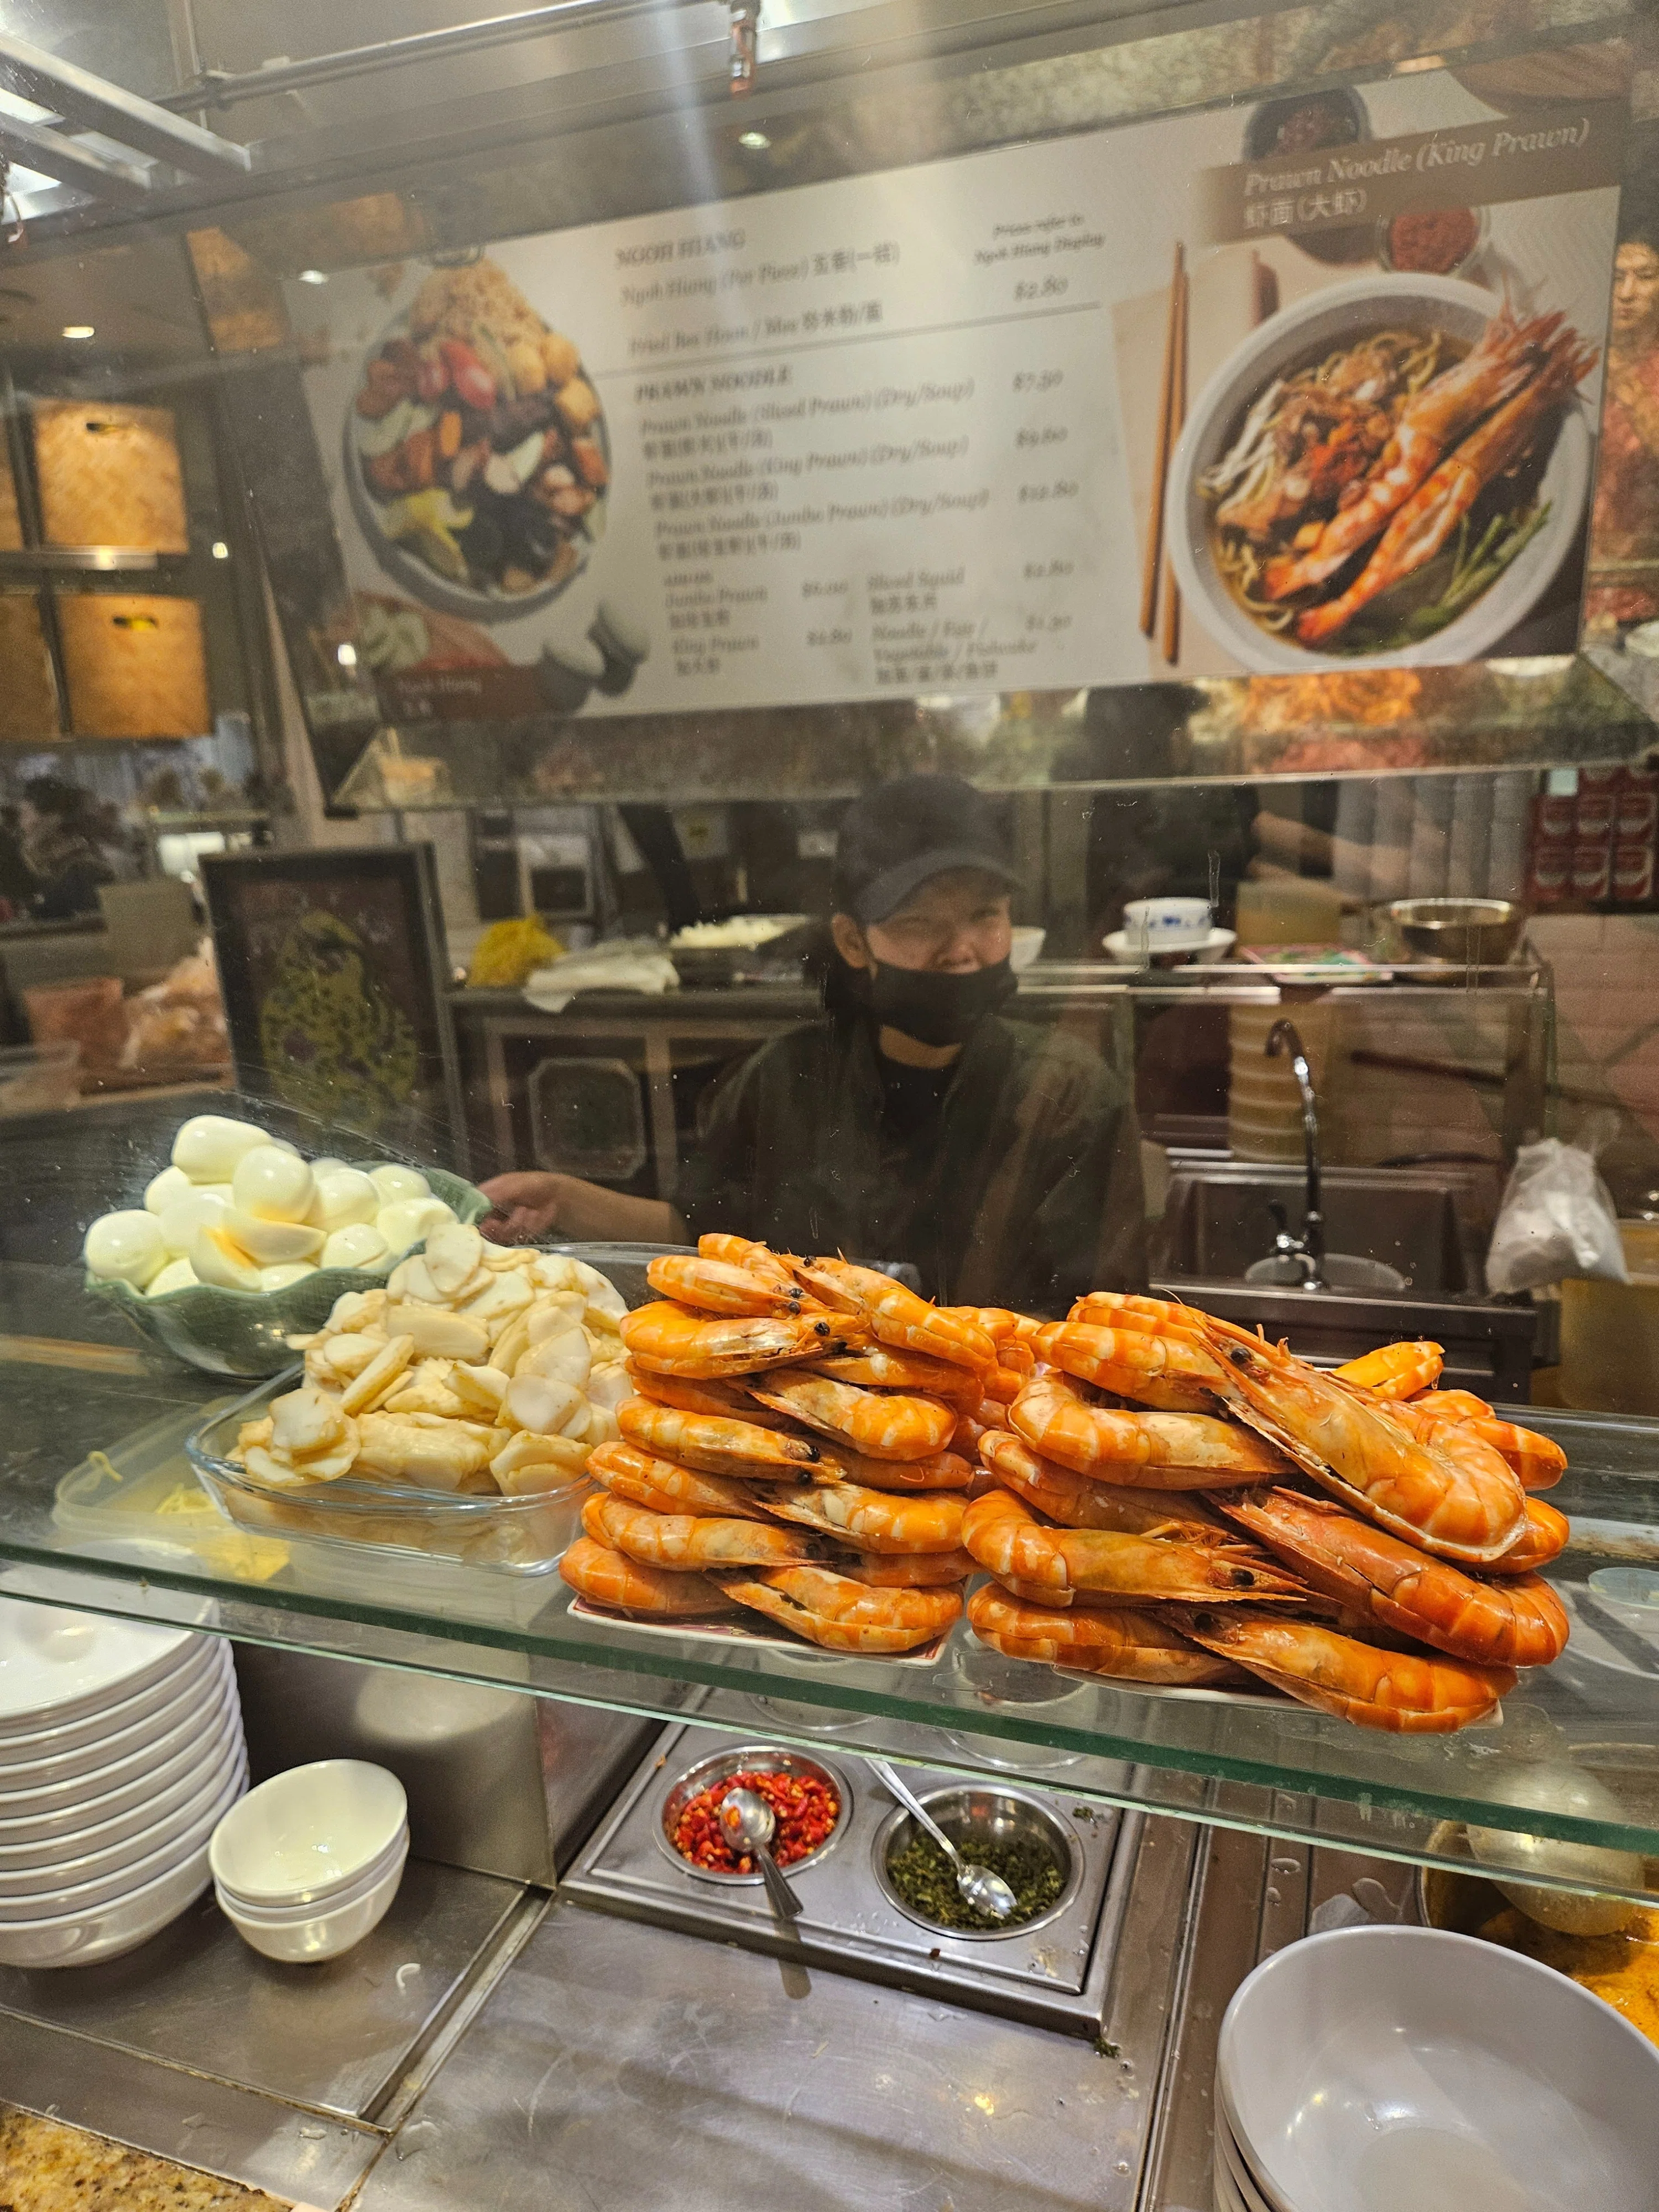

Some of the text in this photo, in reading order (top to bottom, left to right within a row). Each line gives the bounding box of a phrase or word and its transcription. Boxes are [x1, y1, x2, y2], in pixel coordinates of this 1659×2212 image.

[1244, 117, 1590, 196] Prawn Noodle (King Prawn)
[635, 364, 792, 403] PRAWN NOODLE
